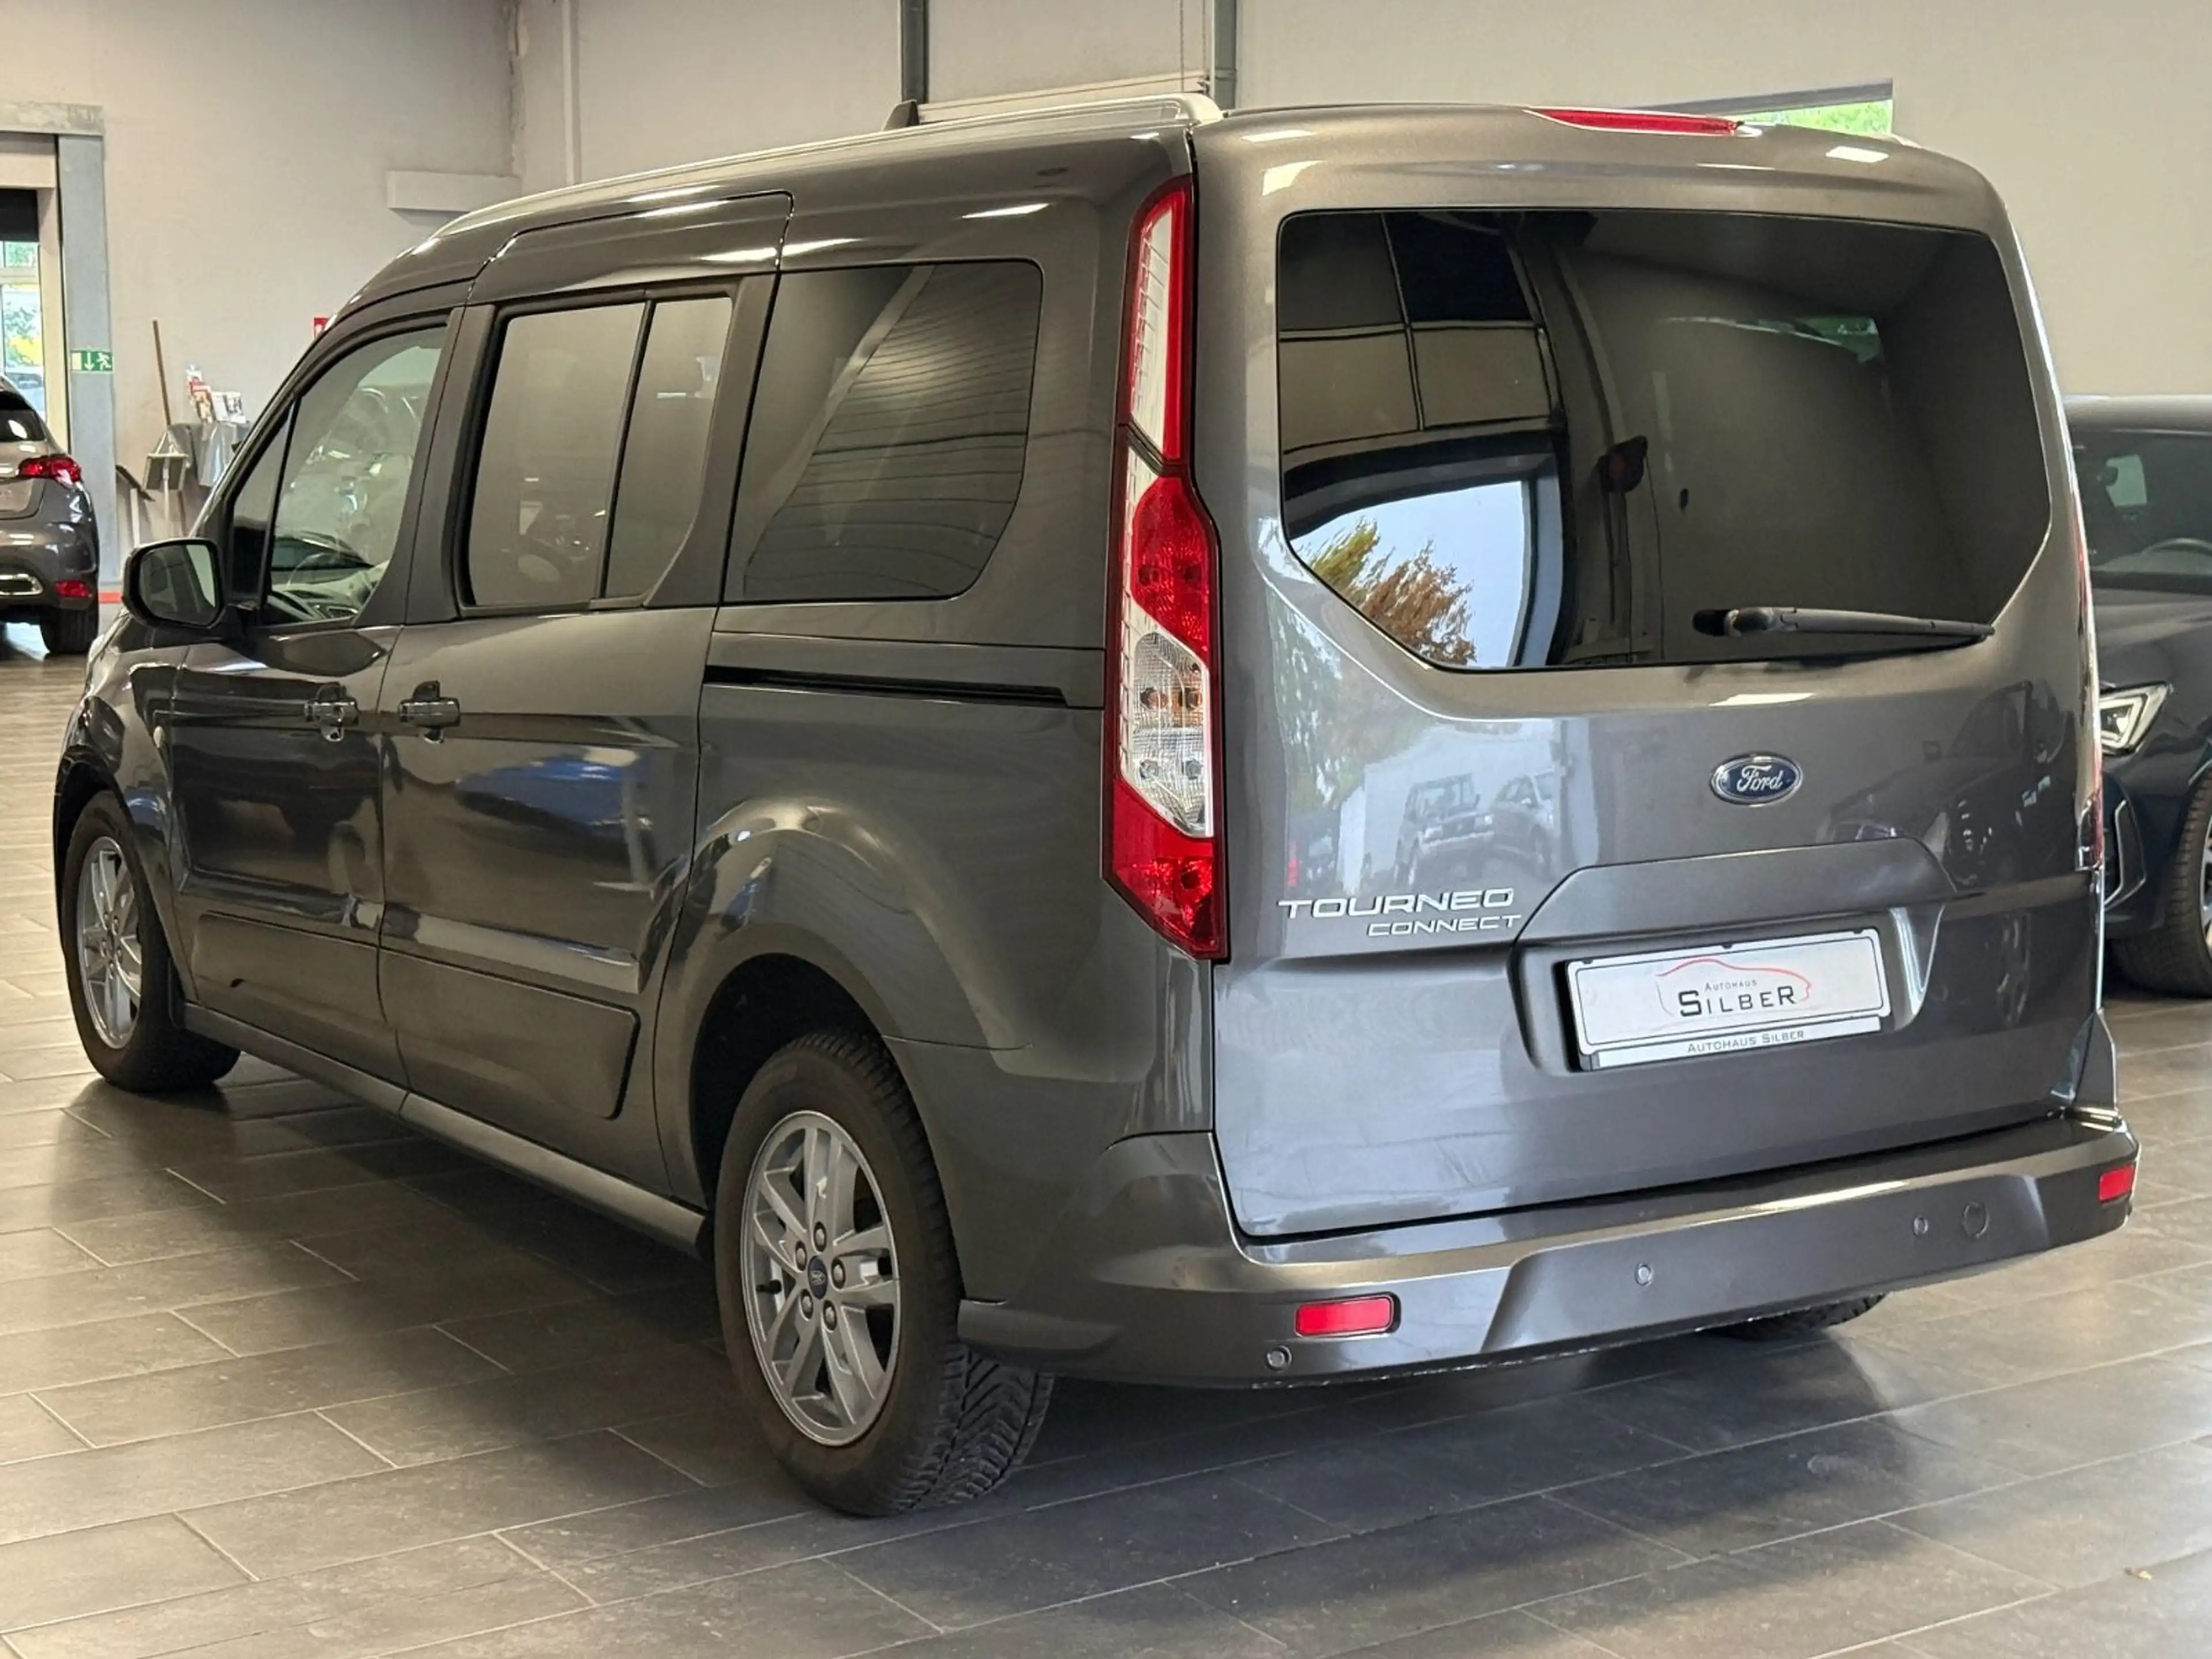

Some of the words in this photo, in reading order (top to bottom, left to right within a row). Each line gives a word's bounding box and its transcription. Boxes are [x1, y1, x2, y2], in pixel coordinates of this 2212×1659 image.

[1736, 764, 1783, 792] Ford
[1277, 888, 1514, 919] TOURNEO
[1367, 914, 1521, 937] CONNECT
[1687, 1036, 1757, 1054] AUTOHAUS
[1762, 1030, 1804, 1044] SILBER
